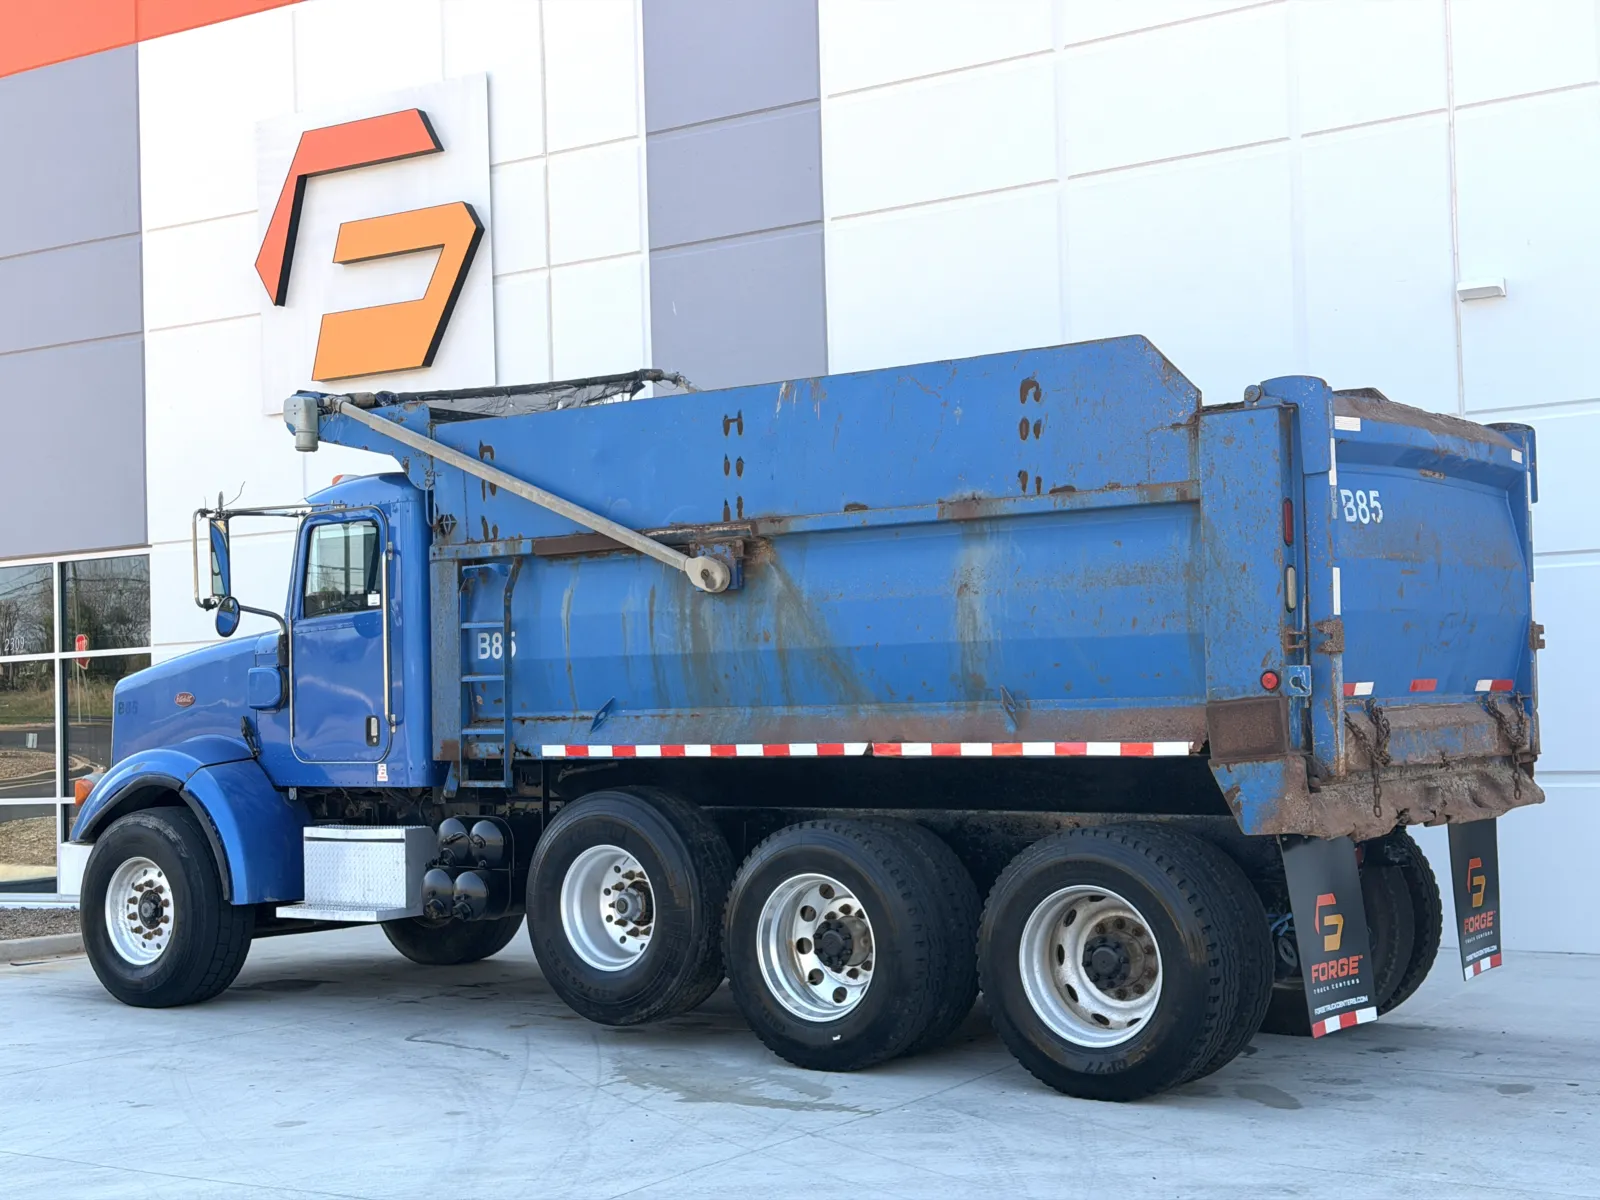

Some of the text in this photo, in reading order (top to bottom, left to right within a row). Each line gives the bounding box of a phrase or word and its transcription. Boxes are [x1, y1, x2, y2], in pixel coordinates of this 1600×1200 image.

[1340, 489, 1384, 525] B85
[4, 636, 25, 652] 2309
[1463, 910, 1494, 936] FORGE
[1311, 955, 1360, 984] FORGE
